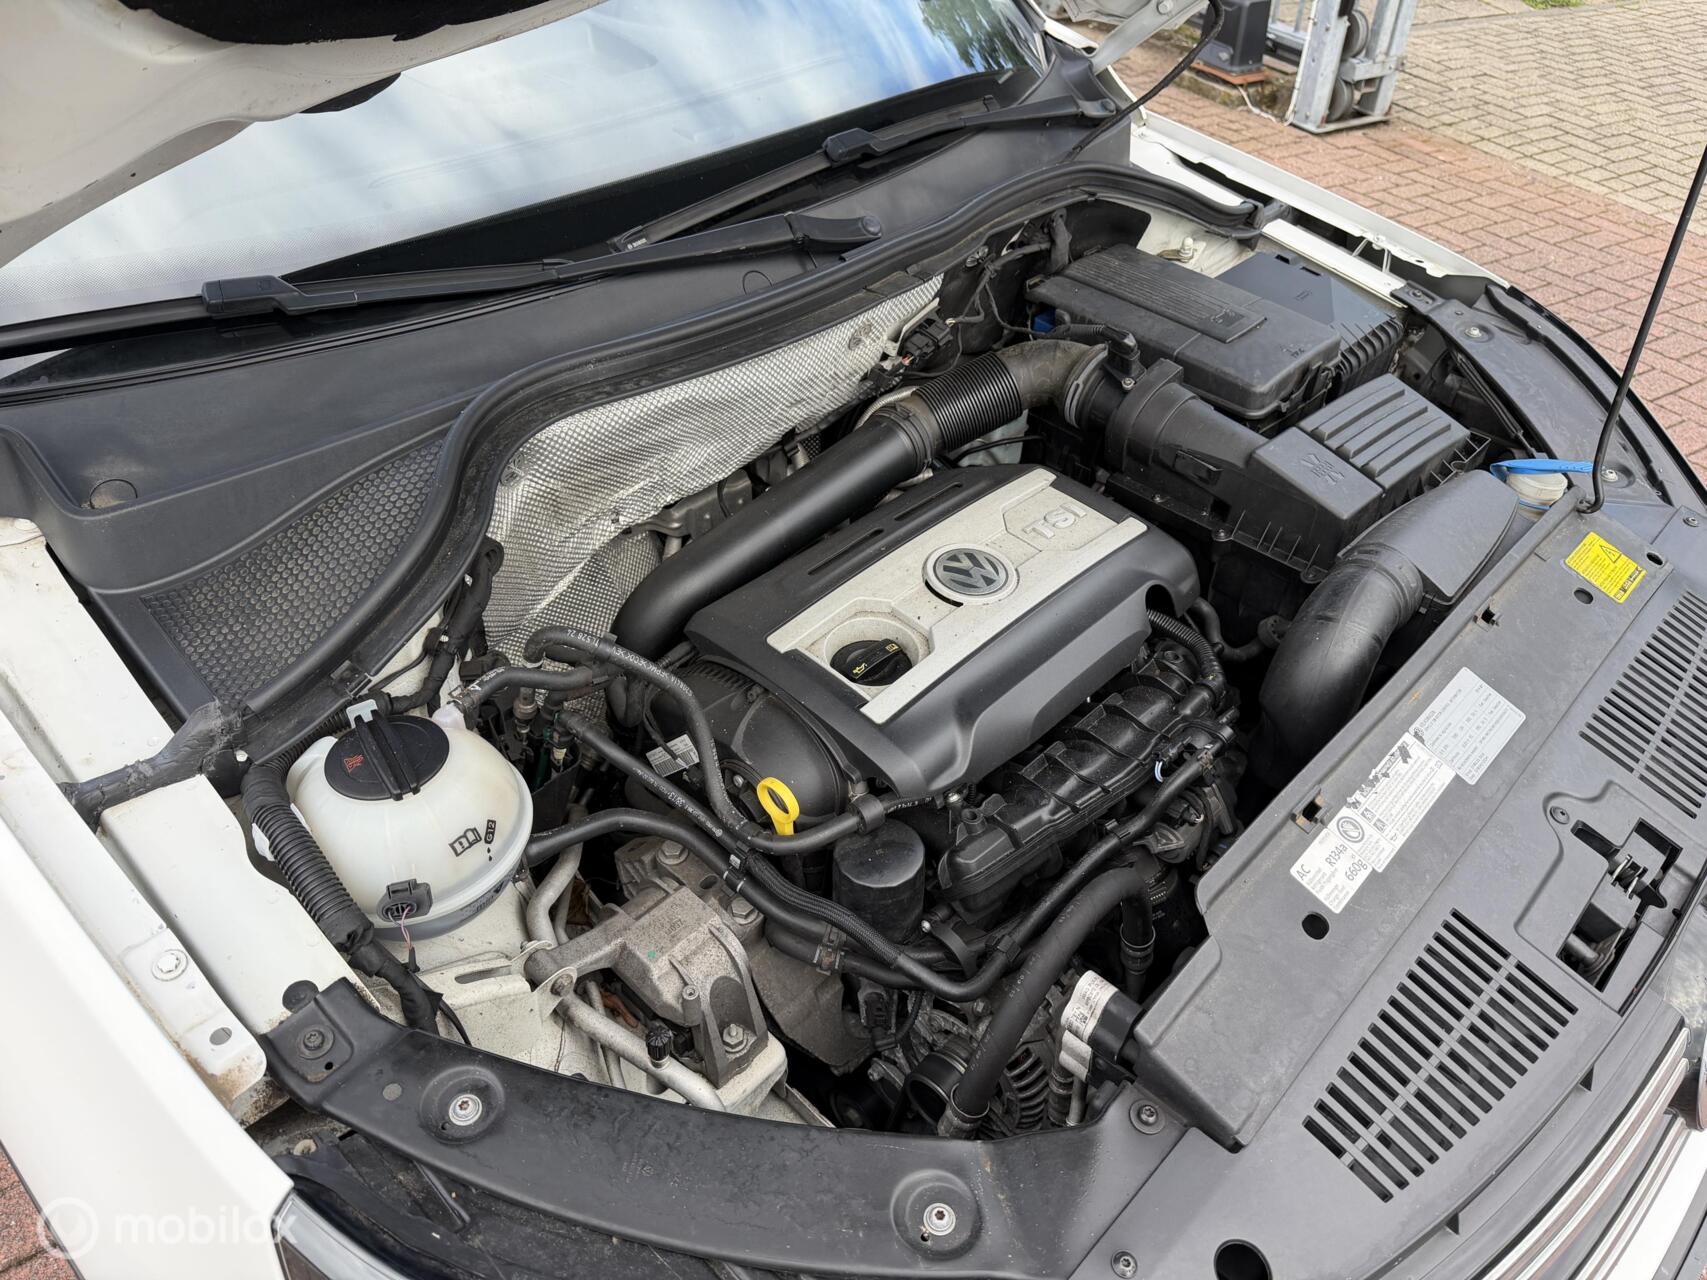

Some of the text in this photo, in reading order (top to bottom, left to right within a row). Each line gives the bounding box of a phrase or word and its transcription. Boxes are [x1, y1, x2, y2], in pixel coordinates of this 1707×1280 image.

[1022, 502, 1087, 539] TSI
[1325, 844, 1348, 867] R134a
[1296, 864, 1311, 881] AC
[1345, 859, 1368, 881] 660g
